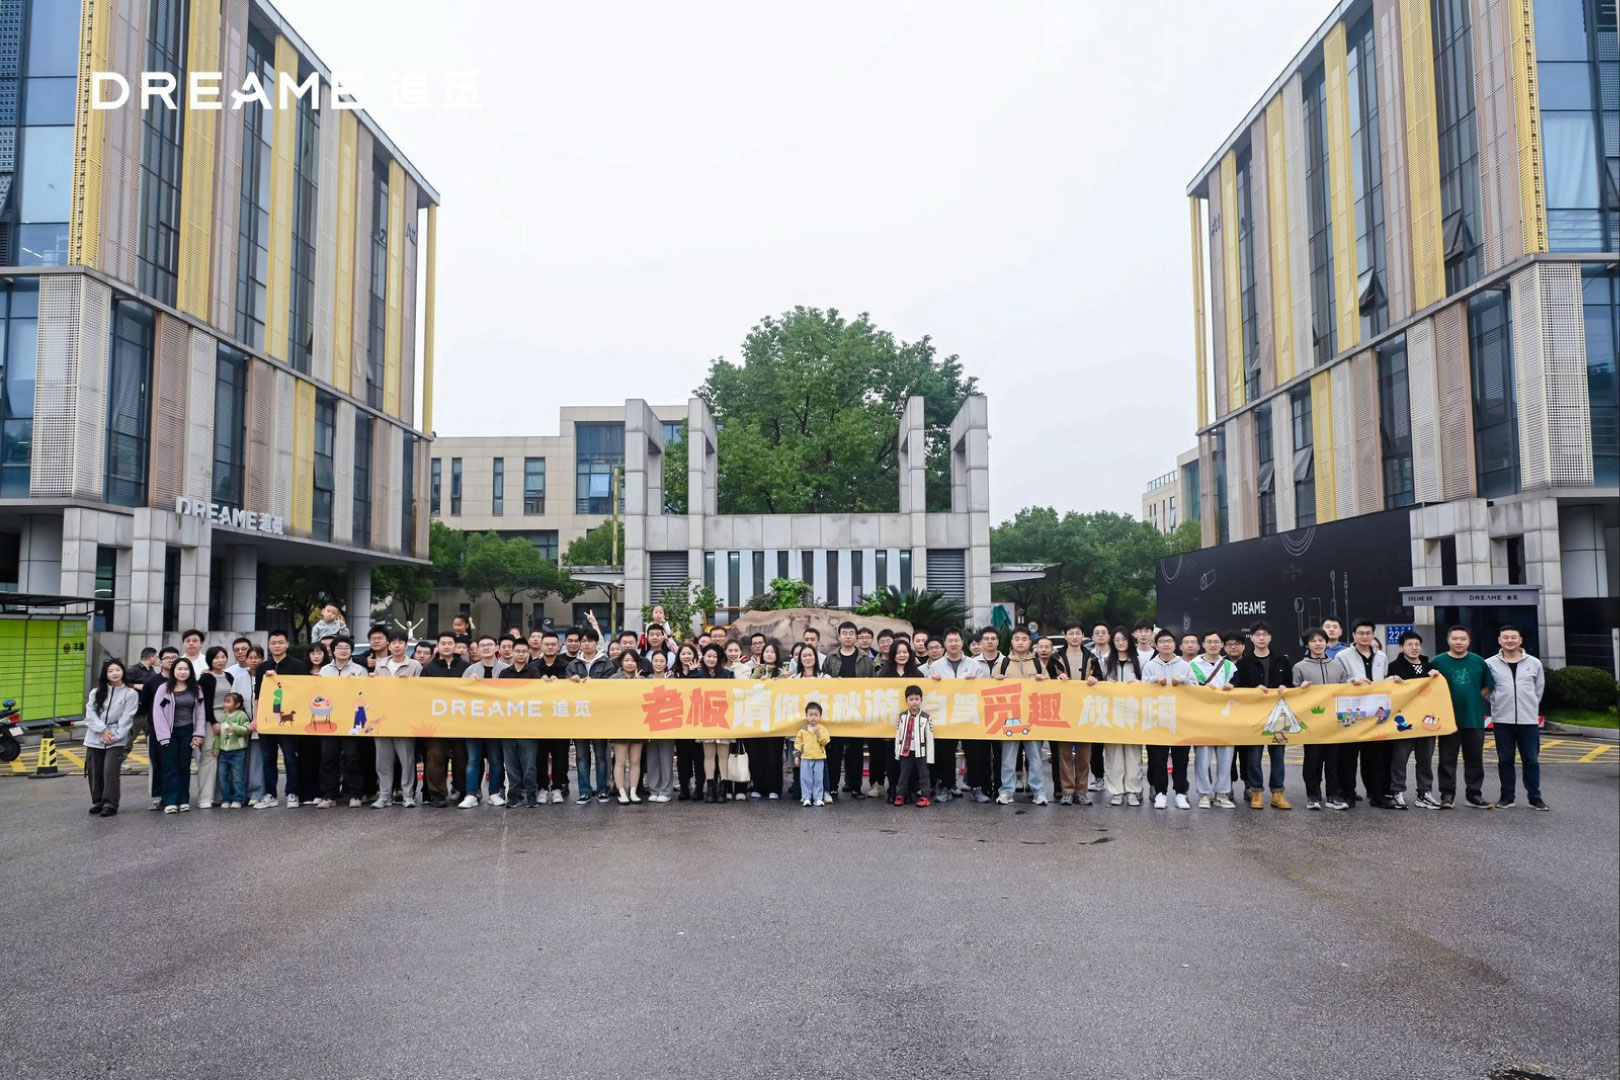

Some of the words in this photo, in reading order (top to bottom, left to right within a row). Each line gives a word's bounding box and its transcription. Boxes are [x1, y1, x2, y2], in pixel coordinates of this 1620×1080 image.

[176, 496, 257, 531] DREAME
[1232, 600, 1266, 615] DREAME
[431, 698, 543, 717] DREAME
[552, 699, 592, 717] 追觅
